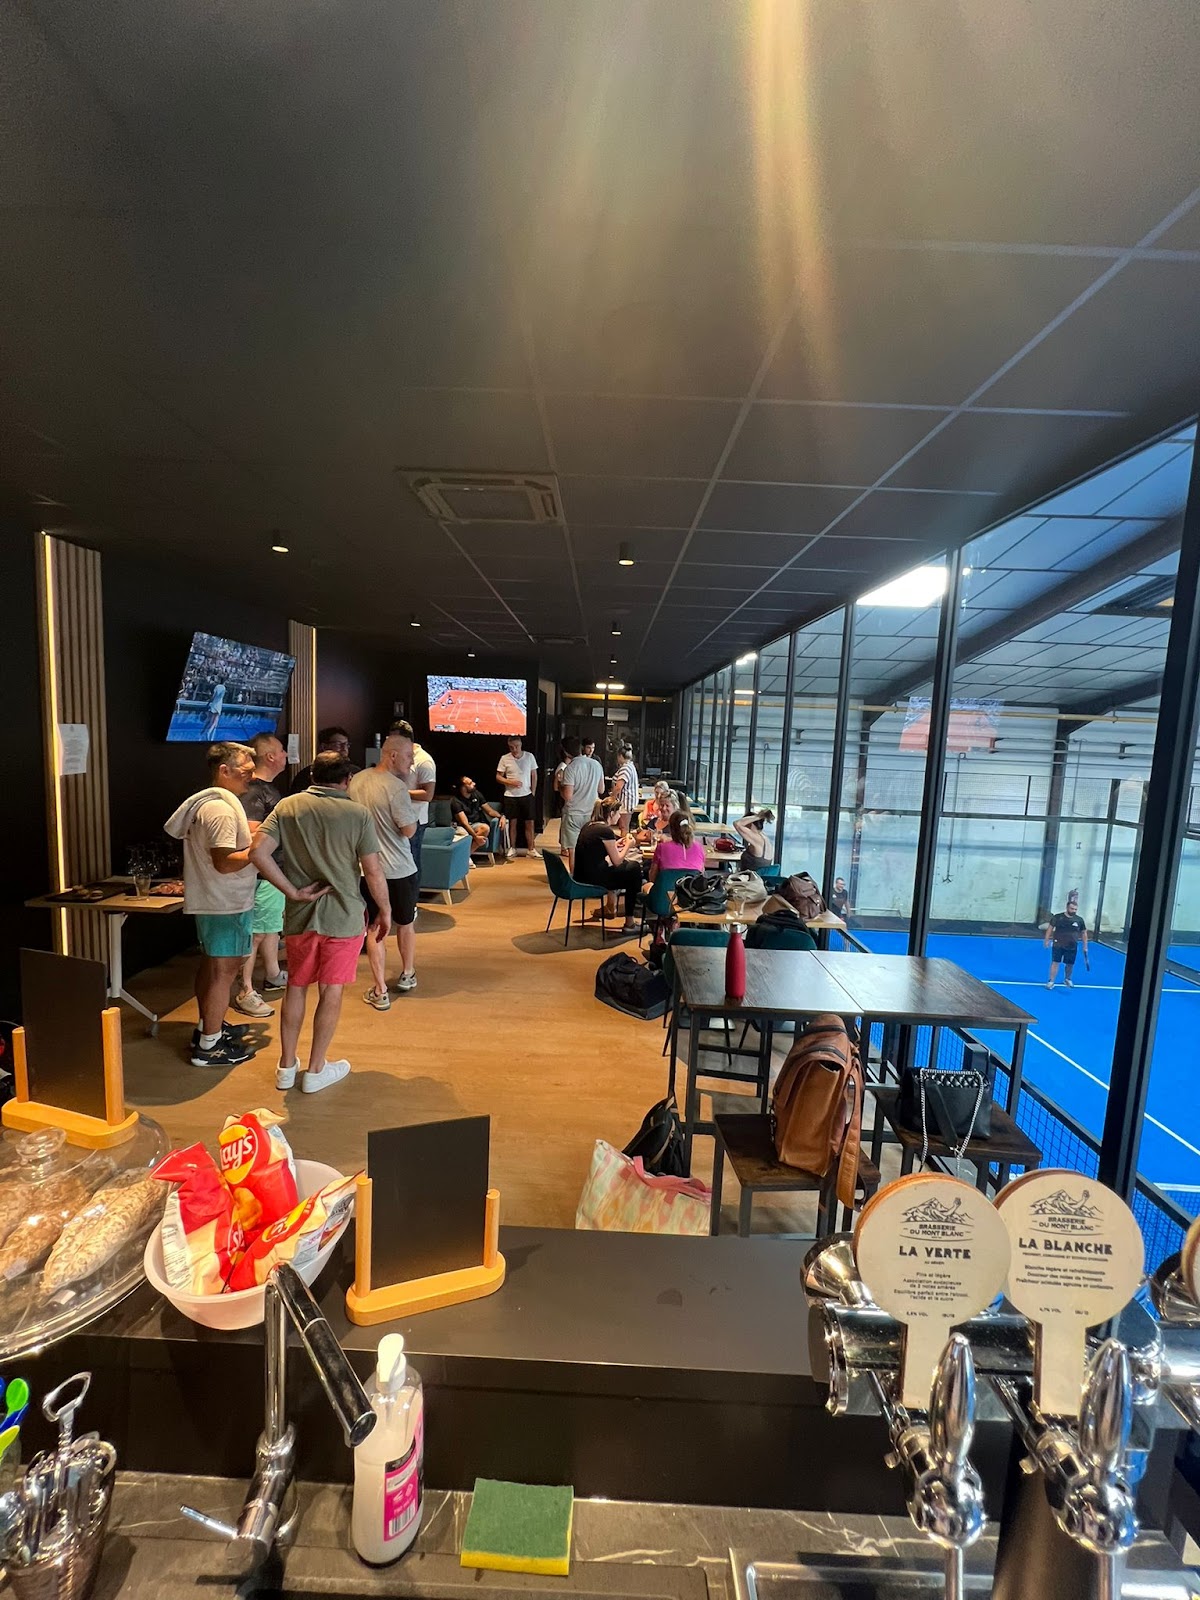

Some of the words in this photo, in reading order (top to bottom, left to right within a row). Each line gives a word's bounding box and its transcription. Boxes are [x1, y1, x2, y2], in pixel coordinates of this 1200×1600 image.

[899, 1246, 918, 1257] LA
[925, 1247, 971, 1259] VERTE
[1019, 1237, 1038, 1249] LA
[1044, 1239, 1113, 1255] BLANCHE
